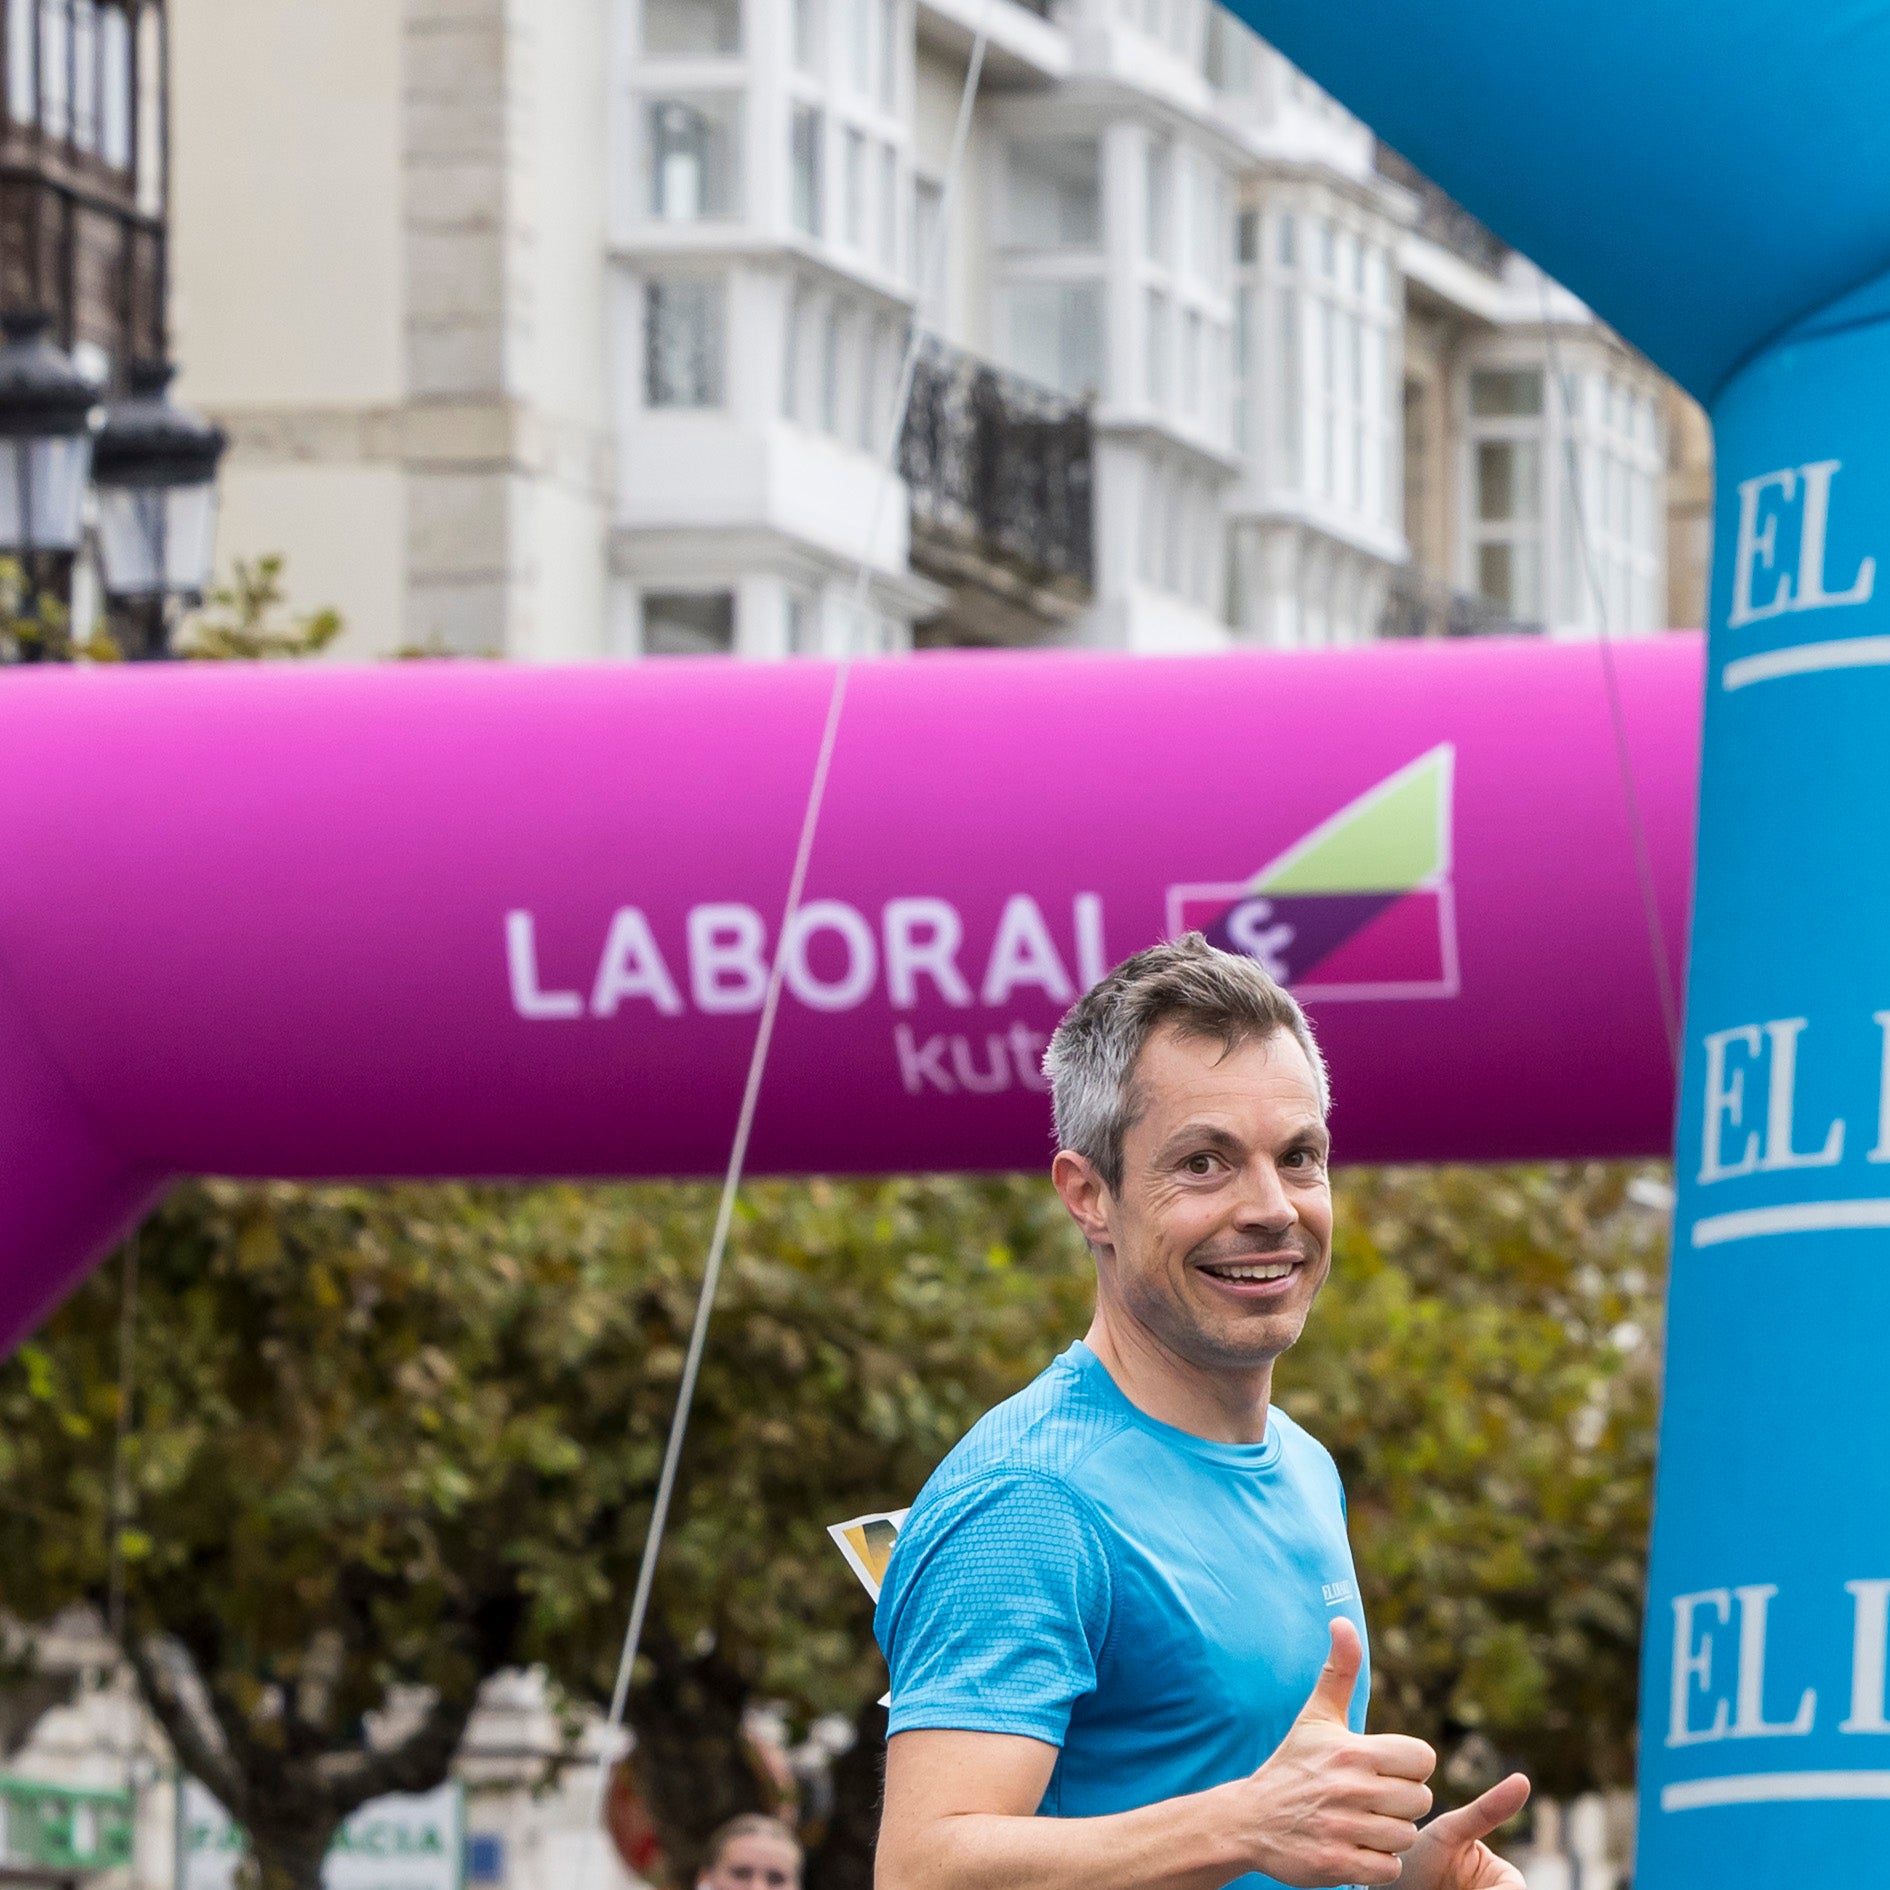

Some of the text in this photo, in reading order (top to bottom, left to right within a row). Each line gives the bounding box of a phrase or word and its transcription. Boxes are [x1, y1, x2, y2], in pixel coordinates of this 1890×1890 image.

[1728, 459, 1877, 629] EL
[893, 1020, 1049, 1097] kut
[1696, 1017, 1846, 1186] EL
[1664, 1583, 1817, 1749] EL
